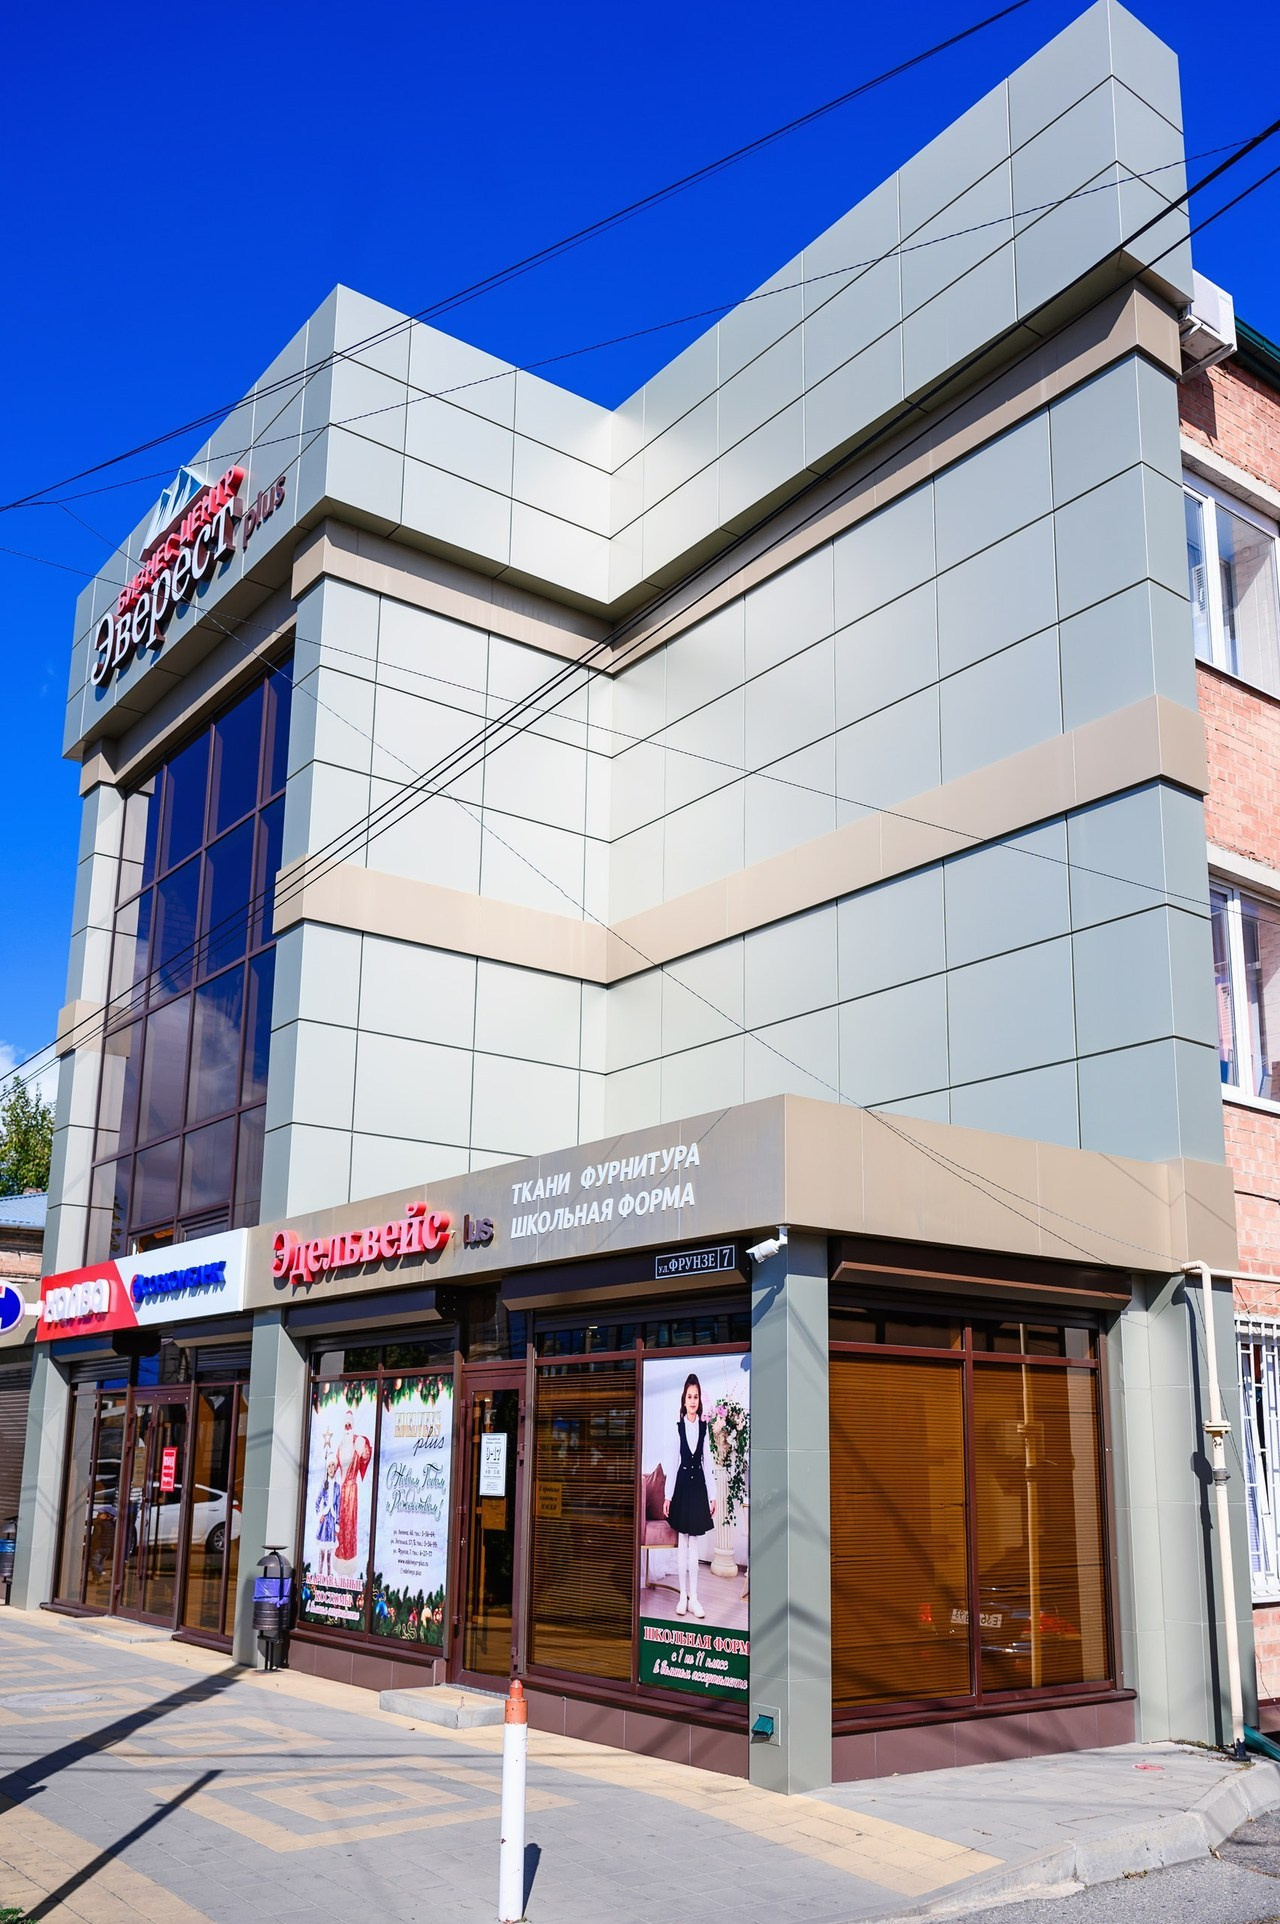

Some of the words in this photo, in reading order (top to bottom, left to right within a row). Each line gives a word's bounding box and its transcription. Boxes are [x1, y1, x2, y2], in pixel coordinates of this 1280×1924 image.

[242, 475, 287, 550] plus
[90, 496, 243, 686] Эверест
[511, 1172, 572, 1205] ТКАНИ
[580, 1142, 701, 1190] ФУРНИТУРА
[510, 1197, 614, 1239] ШКОЛЬНАЯ
[617, 1182, 696, 1219] ФОРМА
[271, 1200, 451, 1285] Эдельвейс
[722, 1249, 730, 1267] 7
[413, 1426, 445, 1456] plus
[643, 1626, 712, 1650] ШКОЛЬНАЯ
[678, 1647, 684, 1663] 1
[695, 1650, 706, 1667] 11
